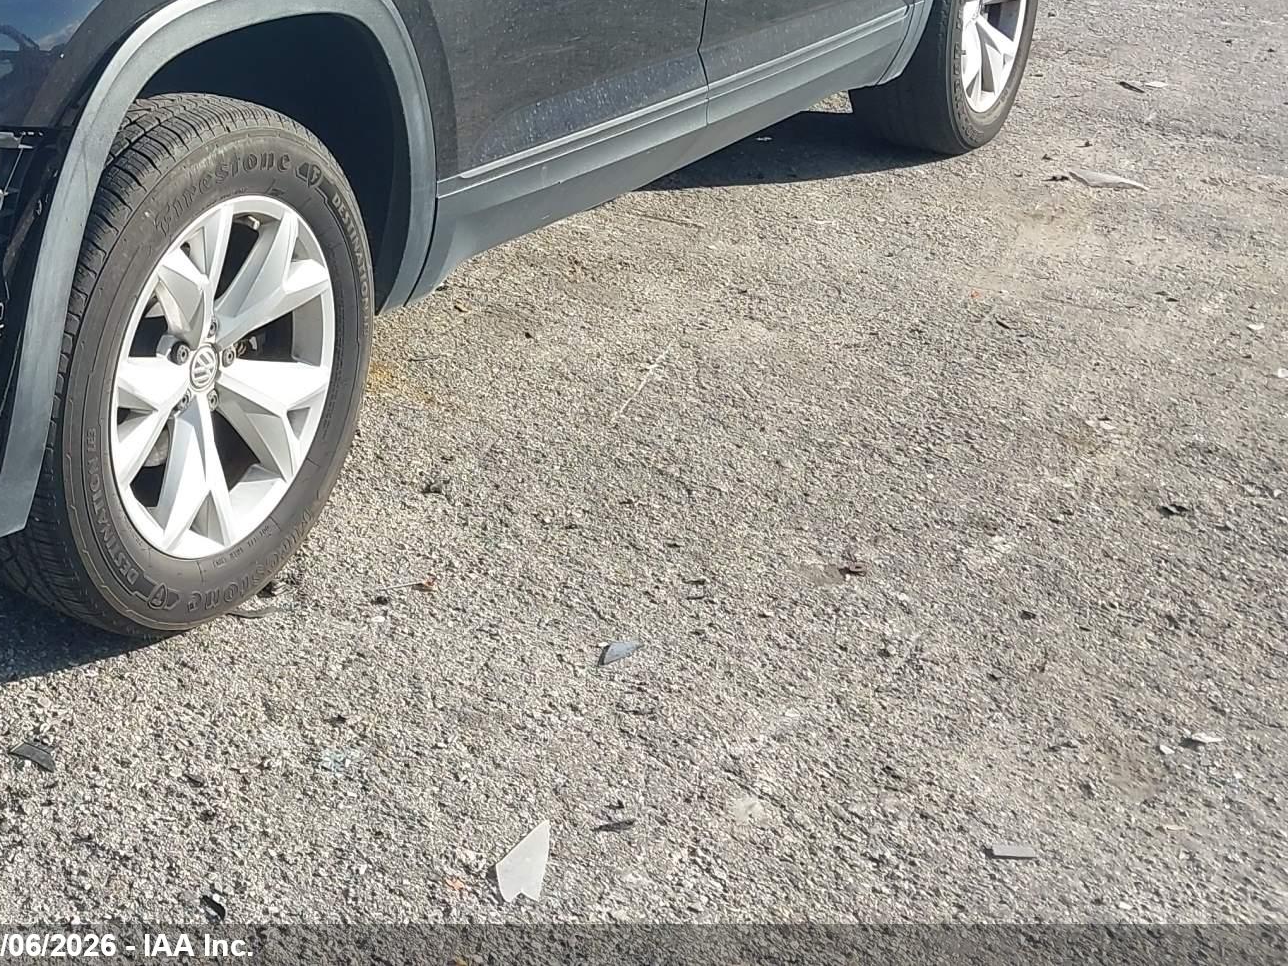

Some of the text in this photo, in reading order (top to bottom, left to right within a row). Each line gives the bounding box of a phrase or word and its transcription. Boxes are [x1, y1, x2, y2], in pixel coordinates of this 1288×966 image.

[153, 151, 291, 236] Firestone
[331, 192, 369, 310] DESTINATION
[87, 456, 142, 585] DESTINATION
